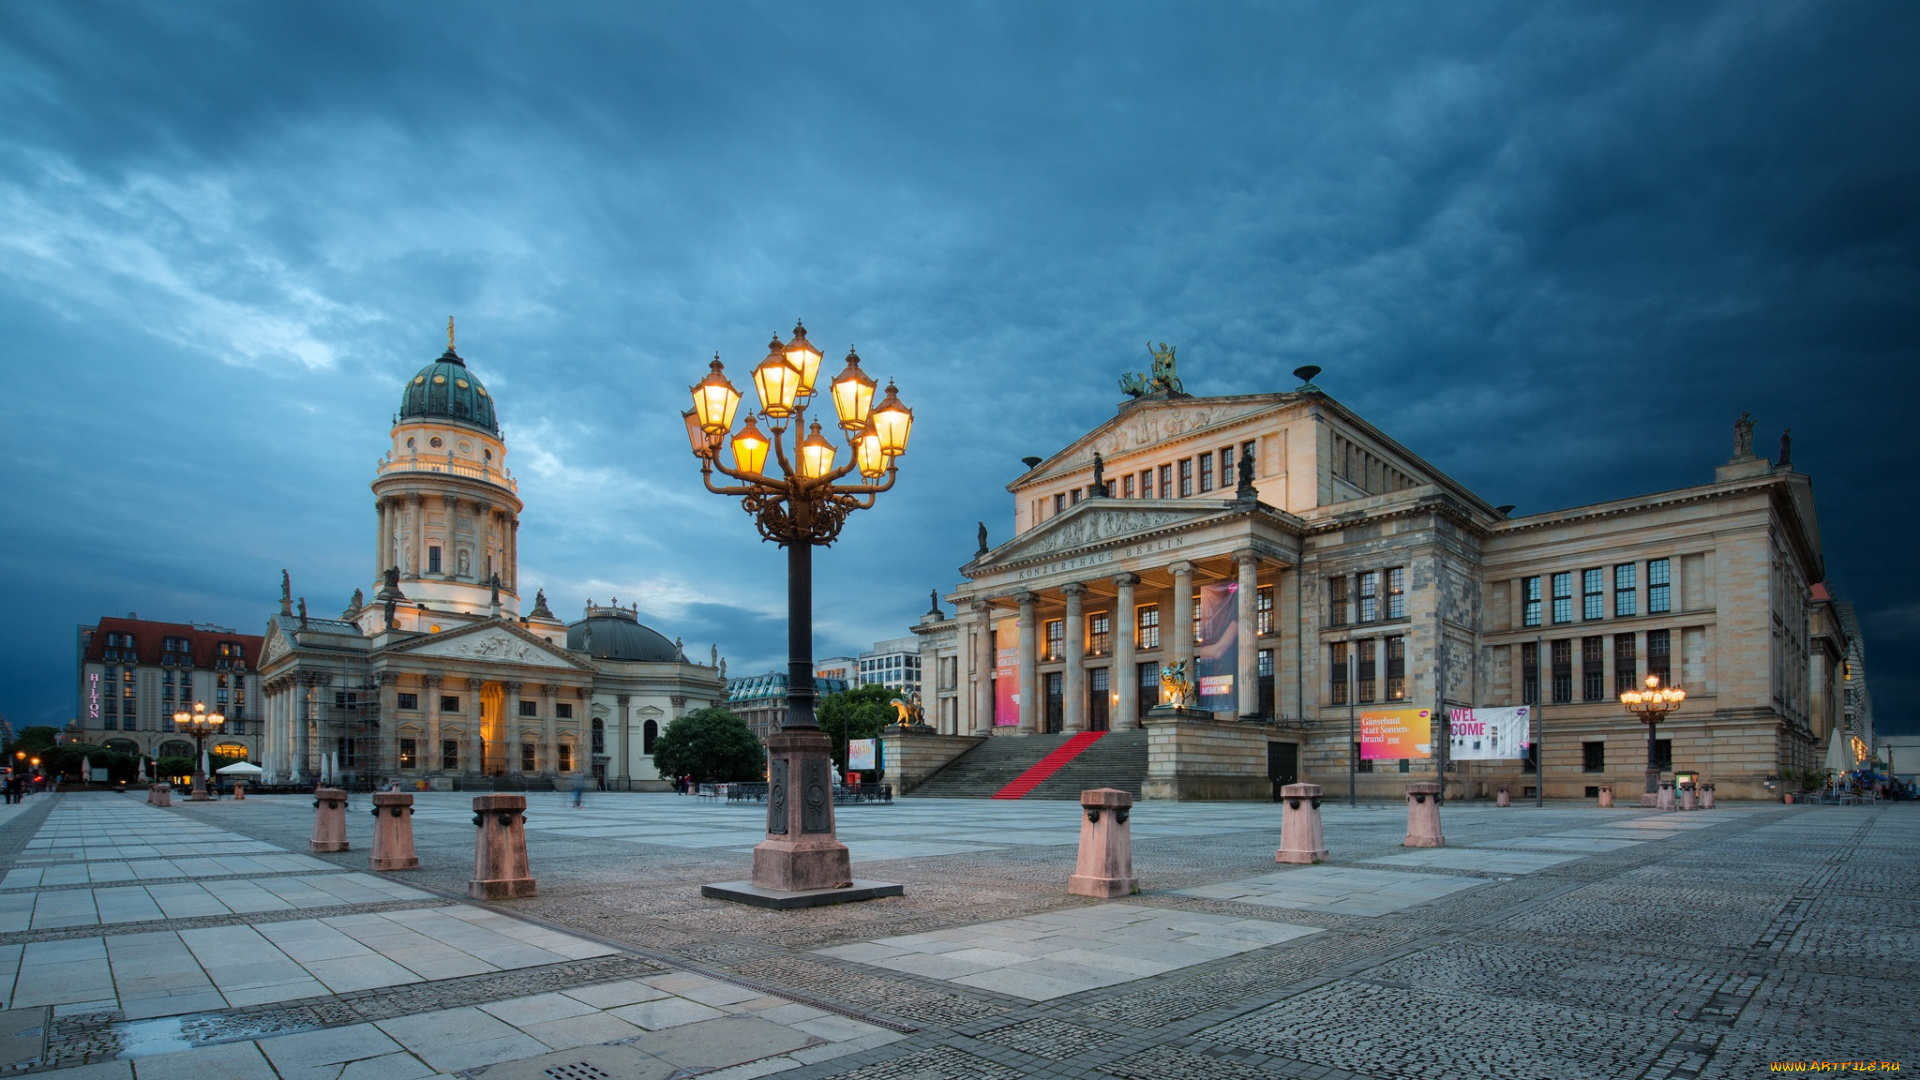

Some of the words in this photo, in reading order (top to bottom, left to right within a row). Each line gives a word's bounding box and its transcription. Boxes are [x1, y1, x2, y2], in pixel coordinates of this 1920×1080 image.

[1019, 552, 1113, 579] KONZERTHAUS
[1126, 537, 1184, 557] BERLIN
[90, 673, 99, 719] HILTON
[1362, 716, 1401, 726] Gänsehaut
[1450, 708, 1477, 721] WEL
[1380, 725, 1410, 734] Sonnen-
[1450, 722, 1486, 736] COME
[1362, 735, 1384, 743] brand
